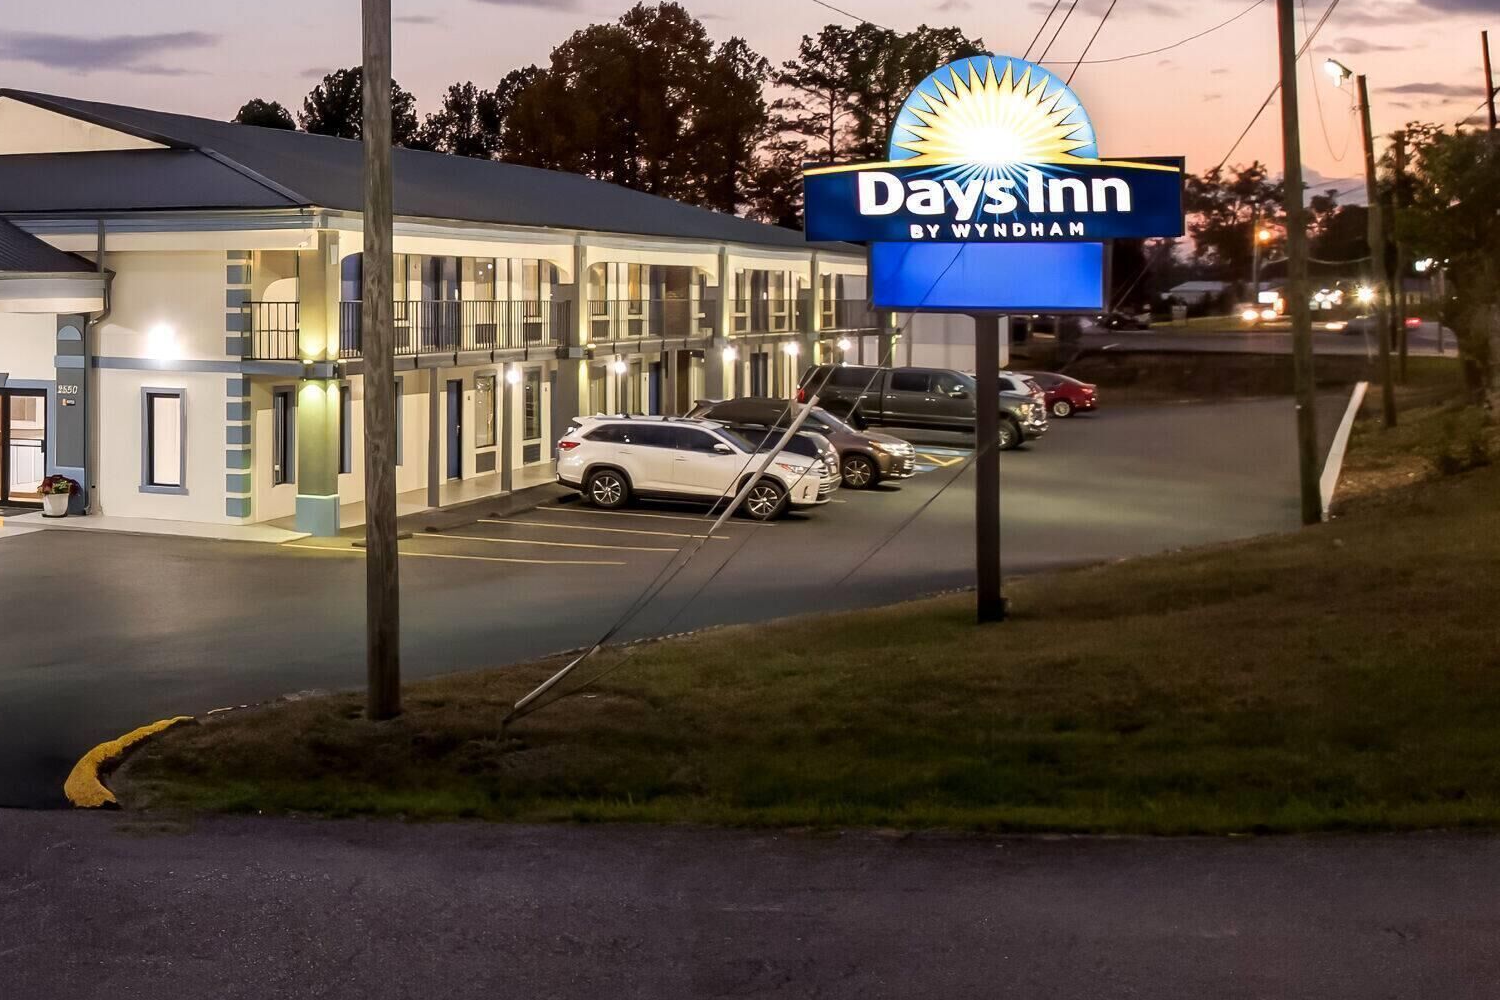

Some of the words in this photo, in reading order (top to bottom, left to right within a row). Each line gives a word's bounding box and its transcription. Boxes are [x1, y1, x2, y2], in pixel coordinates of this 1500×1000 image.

[858, 171, 1016, 221] Days
[1027, 169, 1131, 213] Inn
[910, 224, 940, 239] BY
[951, 221, 1085, 238] WYNDHAM
